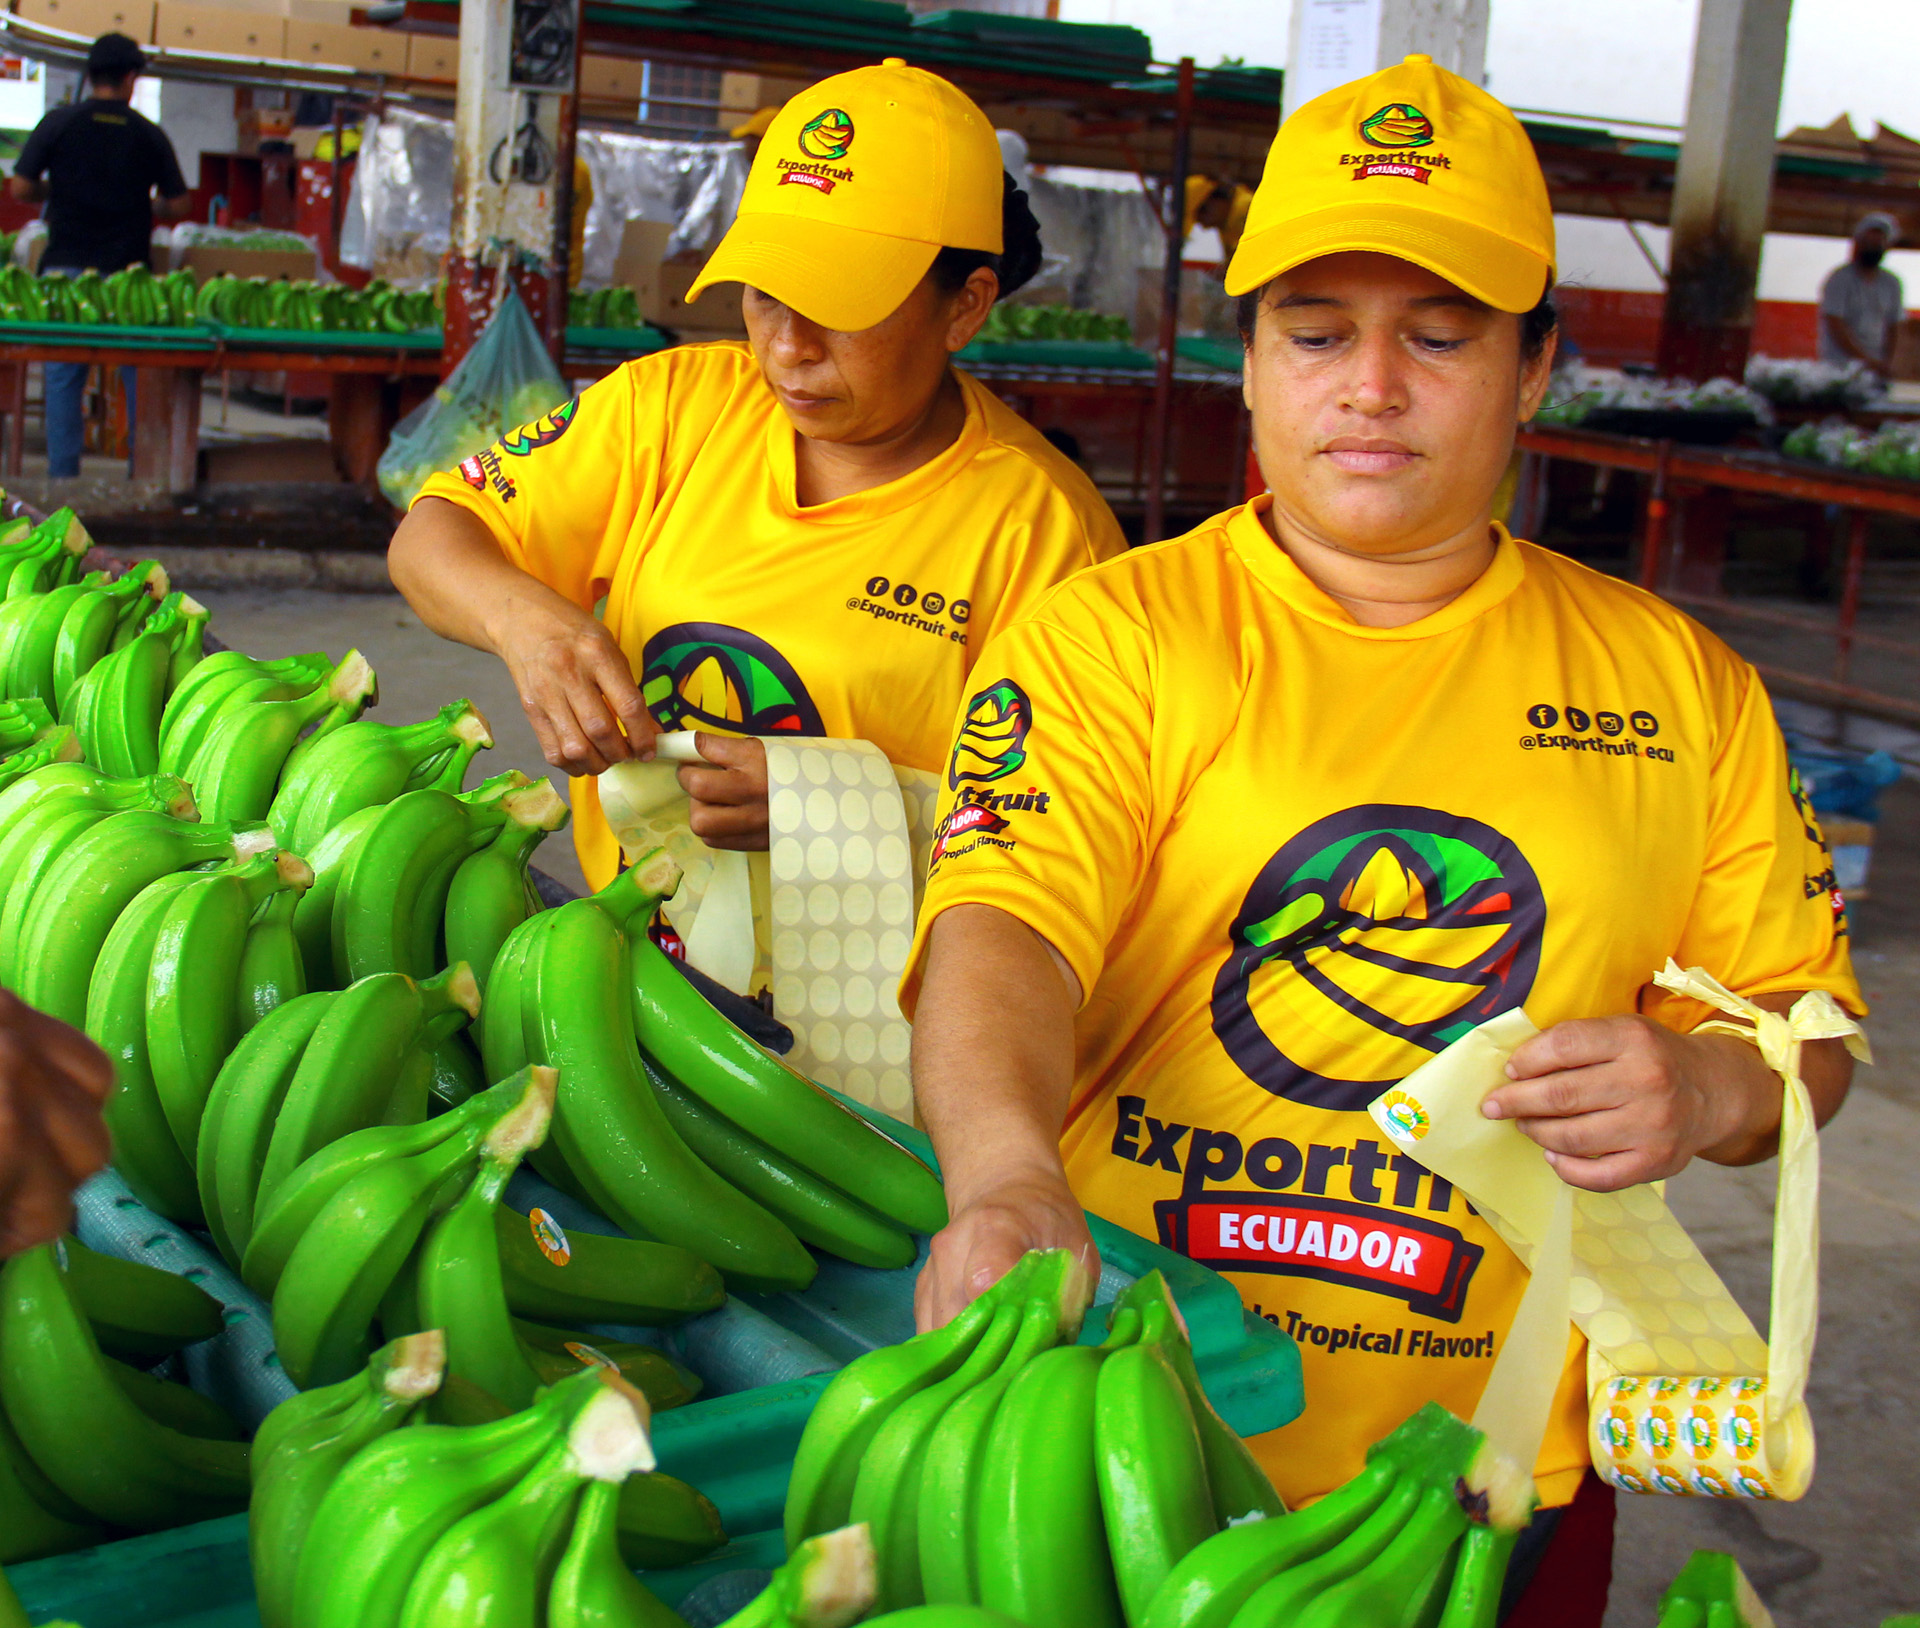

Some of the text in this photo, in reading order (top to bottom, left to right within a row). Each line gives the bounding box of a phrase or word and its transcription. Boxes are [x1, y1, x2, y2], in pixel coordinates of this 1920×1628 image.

[776, 158, 854, 182] Exportfruit
[1339, 151, 1451, 170] Exportfruit
[1366, 164, 1416, 177] ECUADOR
[846, 597, 968, 646] @ExportFruit.ec
[1219, 1212, 1422, 1277] ECUADOR
[1286, 1310, 1403, 1355] Tropical
[1406, 1330, 1494, 1358] Flavor!
